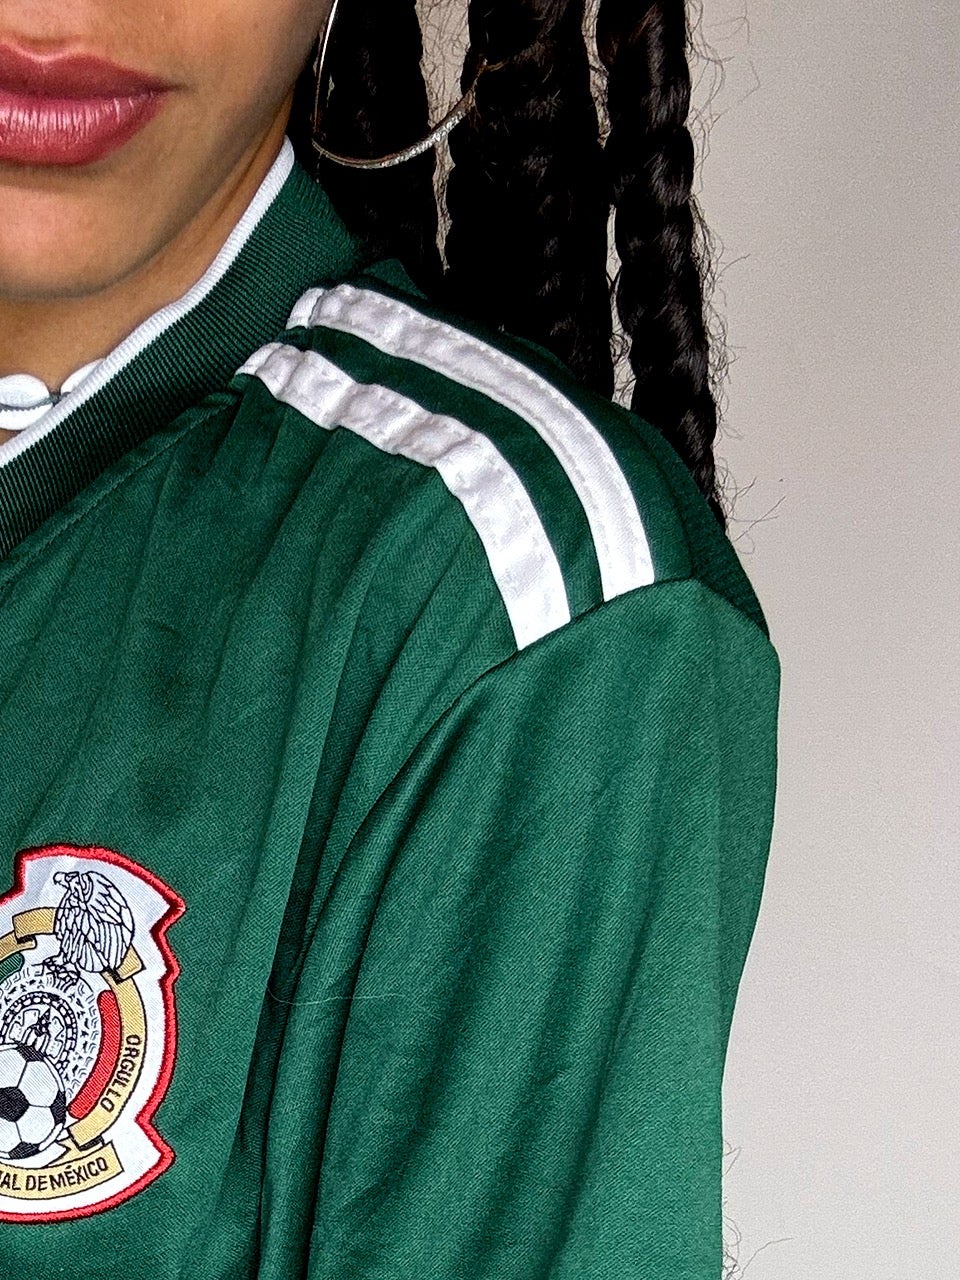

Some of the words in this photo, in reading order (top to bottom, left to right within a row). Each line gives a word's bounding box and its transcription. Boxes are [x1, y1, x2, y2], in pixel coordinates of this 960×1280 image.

[100, 1034, 142, 1113] ORGULLO
[25, 1174, 48, 1191] DE
[49, 1156, 109, 1191] MÉXICO
